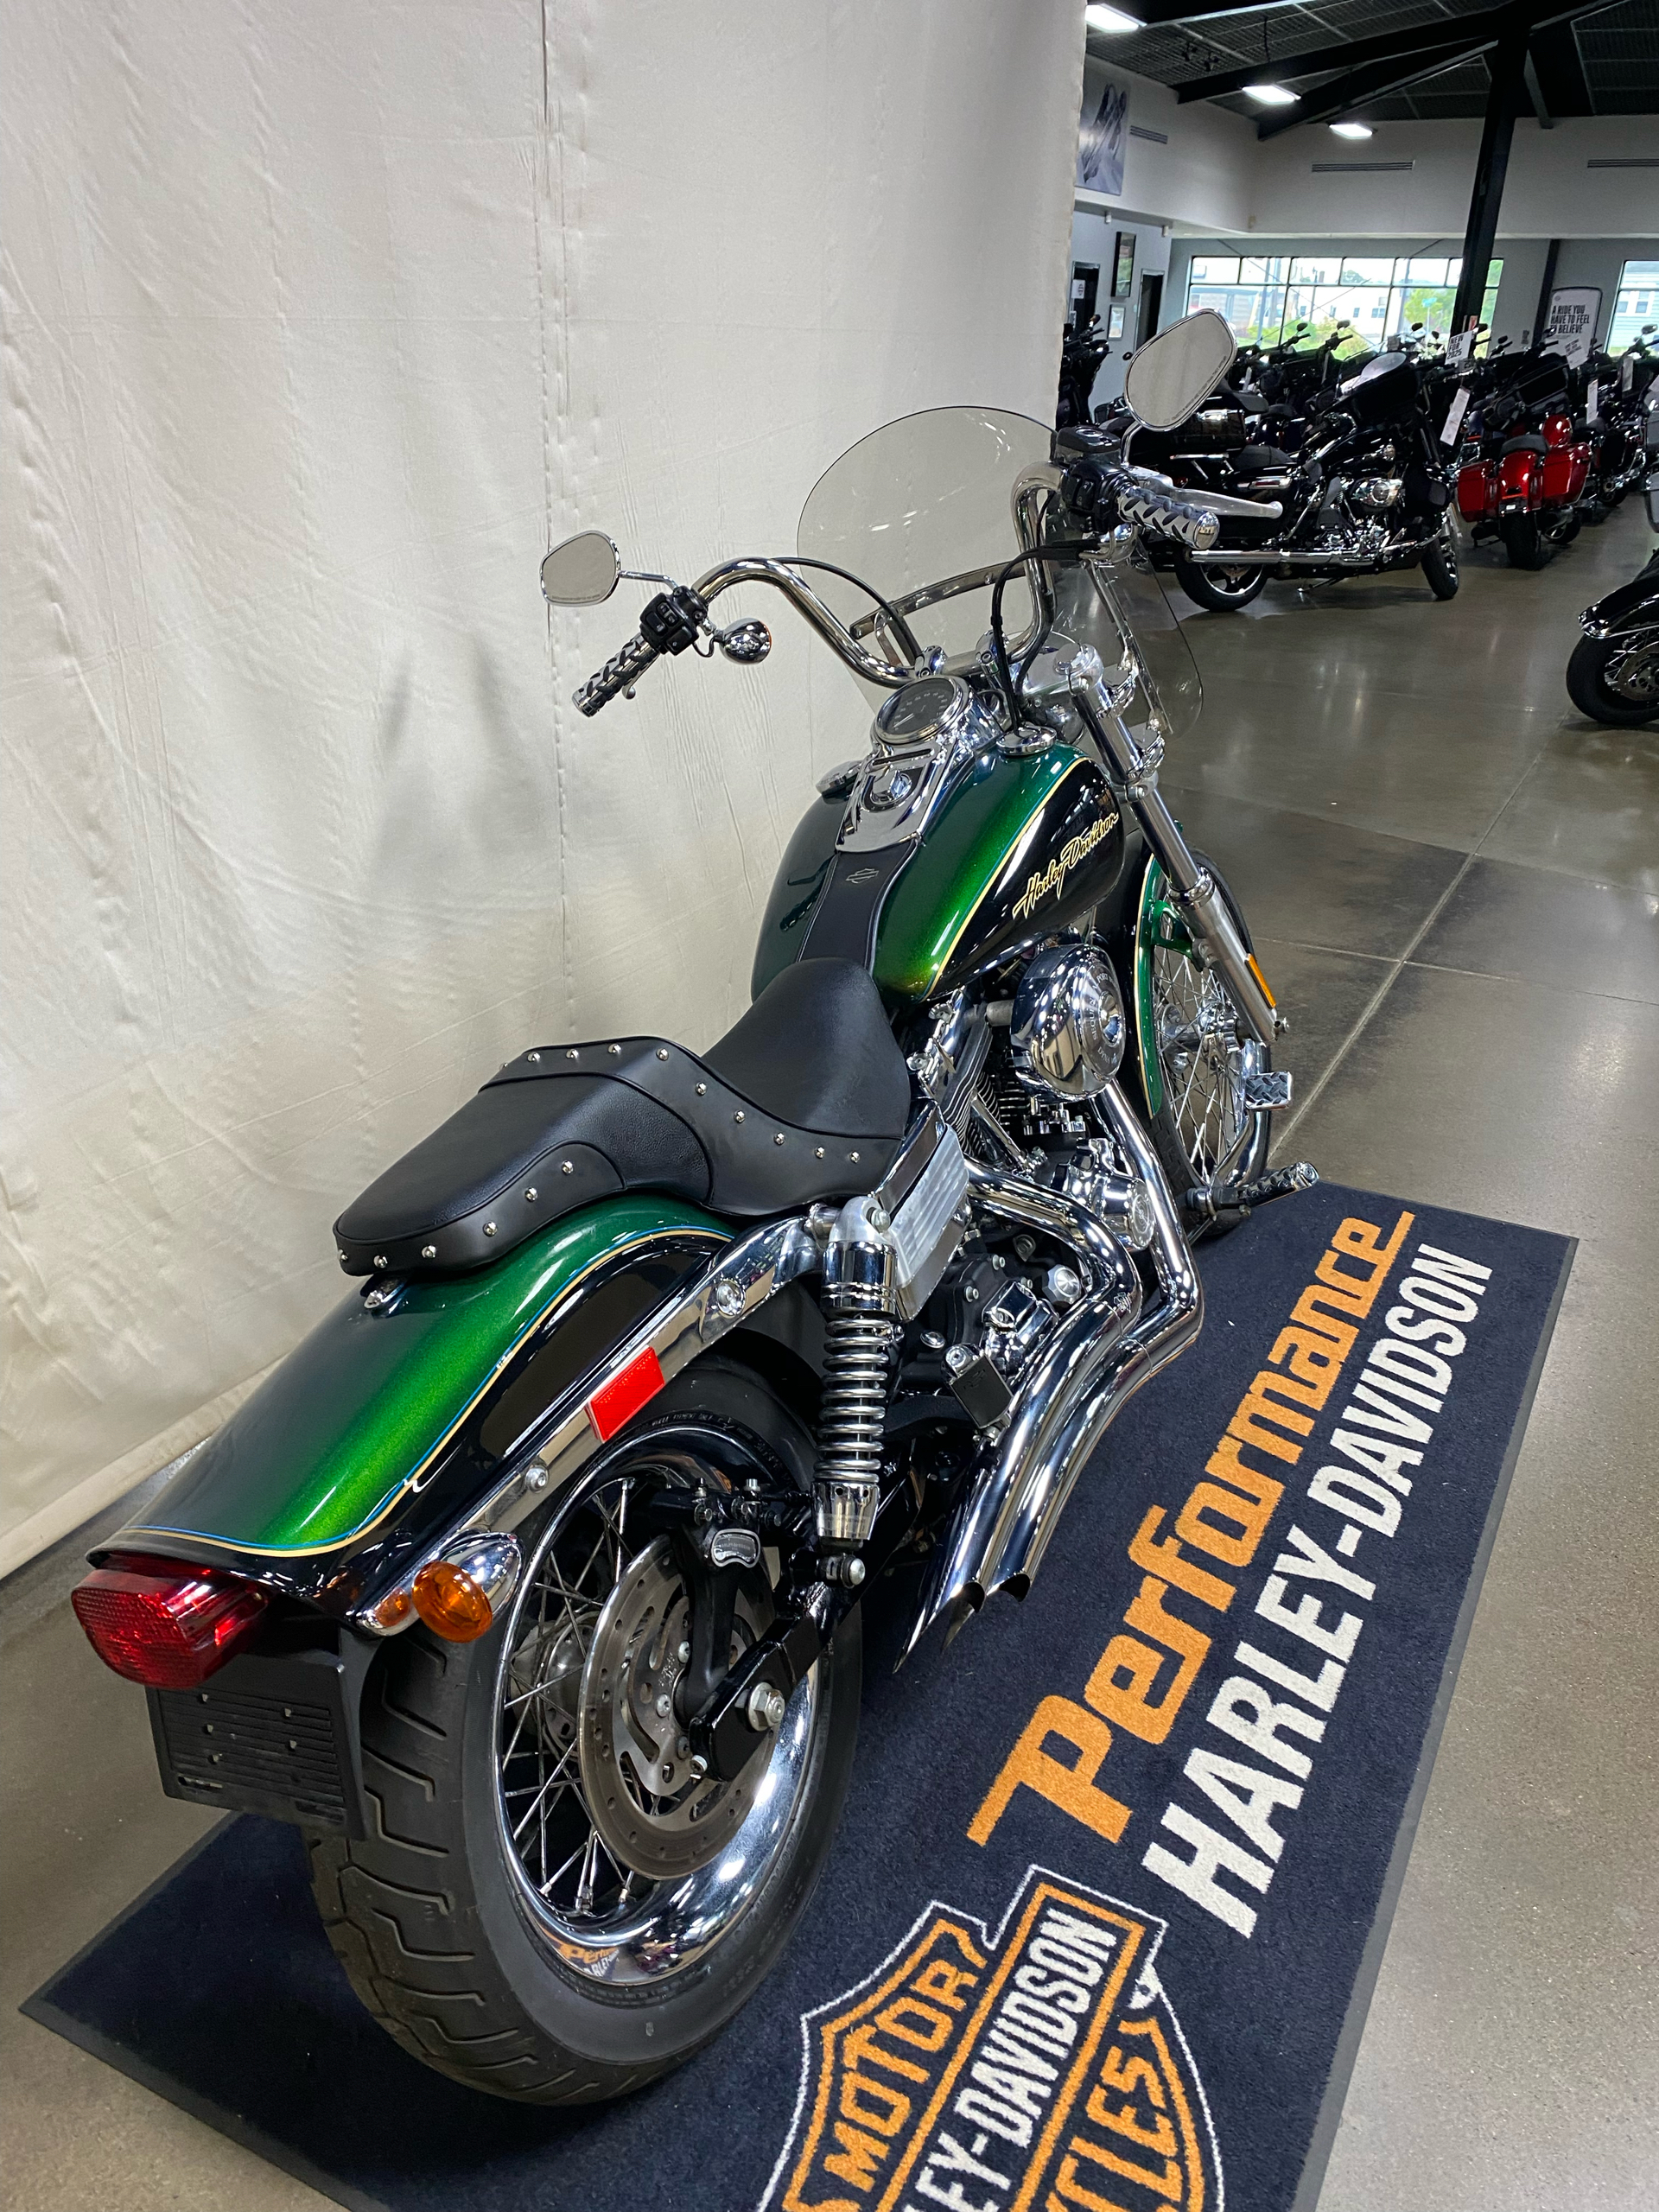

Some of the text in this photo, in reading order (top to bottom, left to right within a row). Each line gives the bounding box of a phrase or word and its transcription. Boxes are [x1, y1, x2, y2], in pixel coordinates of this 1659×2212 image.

[1552, 304, 1586, 315] A RIDE YOU
[1551, 315, 1590, 324] HAVE TO FEEL
[1558, 324, 1583, 334] BELIEVE
[1451, 334, 1465, 344] NEW
[1449, 342, 1460, 352] FOR
[1447, 348, 1462, 359] 2025
[967, 1211, 1415, 1847] Performance
[1141, 1243, 1493, 1939] HARLEY-DAVIDSON
[905, 1908, 1116, 2212] EY-DAVIDSON
[823, 1960, 977, 2192] MOTOR
[1046, 2045, 1184, 2212] CLES
